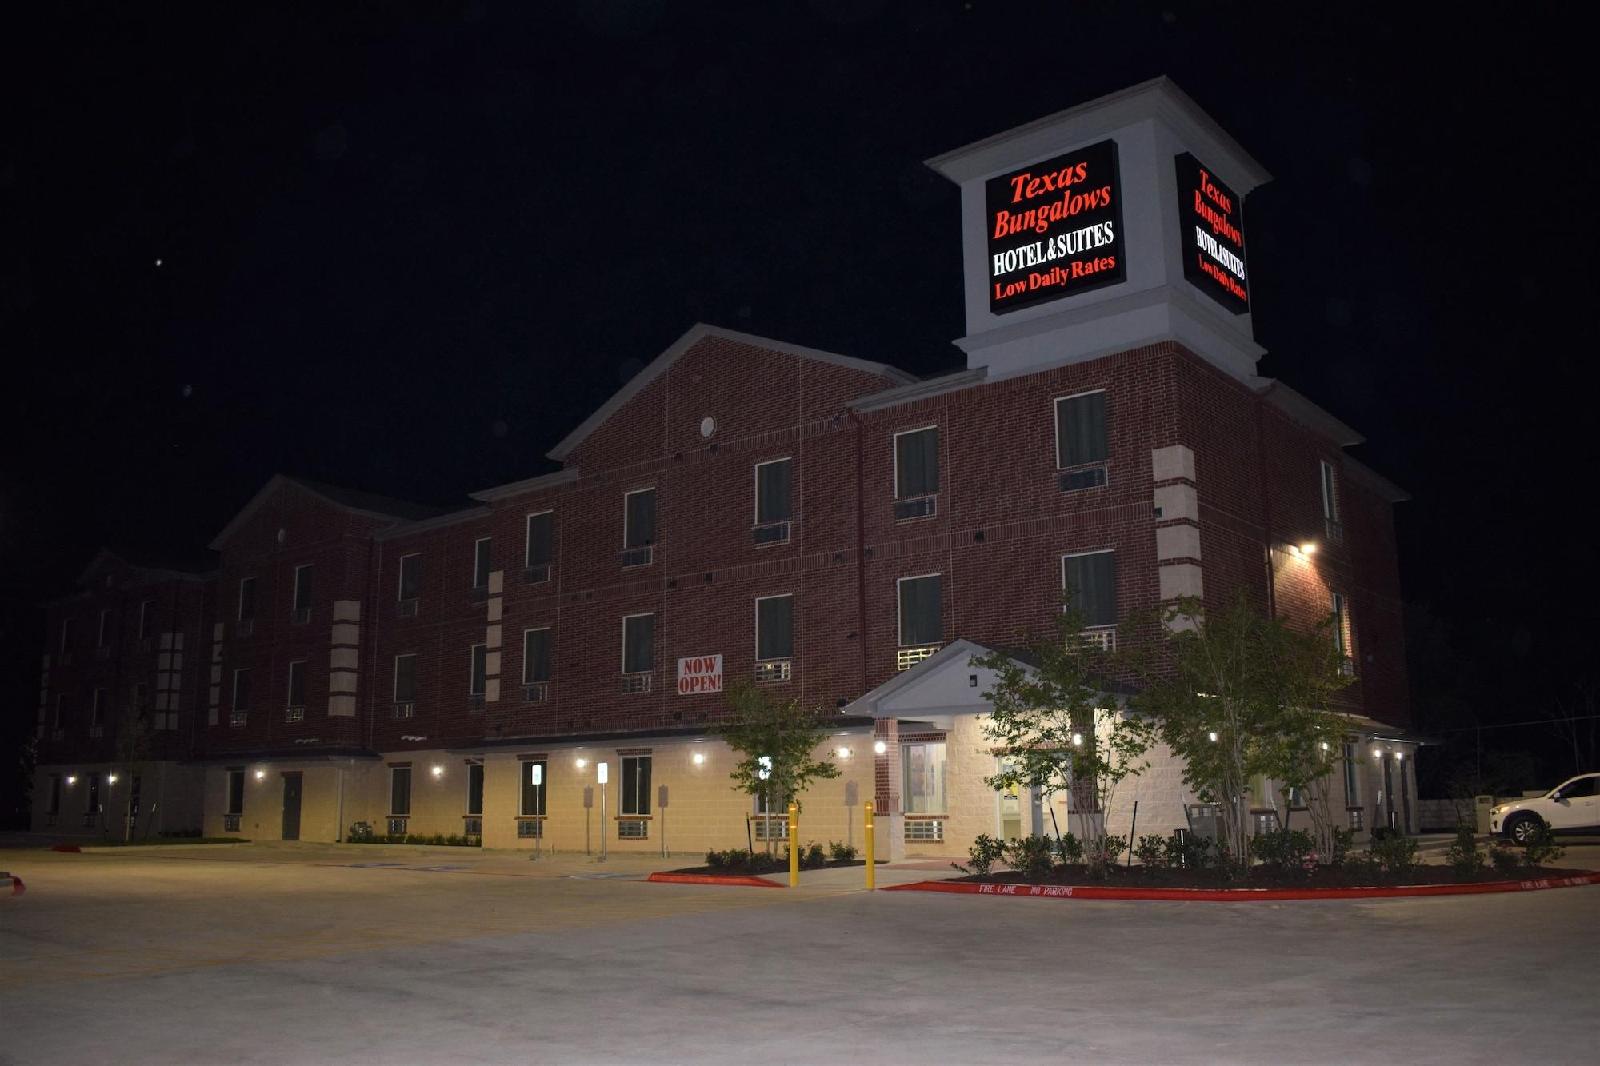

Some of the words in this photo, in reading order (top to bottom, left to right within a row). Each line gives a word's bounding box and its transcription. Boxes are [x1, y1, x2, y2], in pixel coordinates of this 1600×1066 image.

[1011, 162, 1088, 203] Texas
[1200, 169, 1231, 214] Texas
[992, 186, 1111, 239] Bungalows
[1195, 190, 1242, 247] Bungalows
[995, 279, 1027, 300] Low
[1029, 266, 1070, 290] Daily
[1071, 256, 1116, 279] Rates
[679, 674, 721, 693] OPEN!
[684, 656, 716, 675] NOW
[979, 884, 995, 893] FIRE
[997, 885, 1017, 894] LANE
